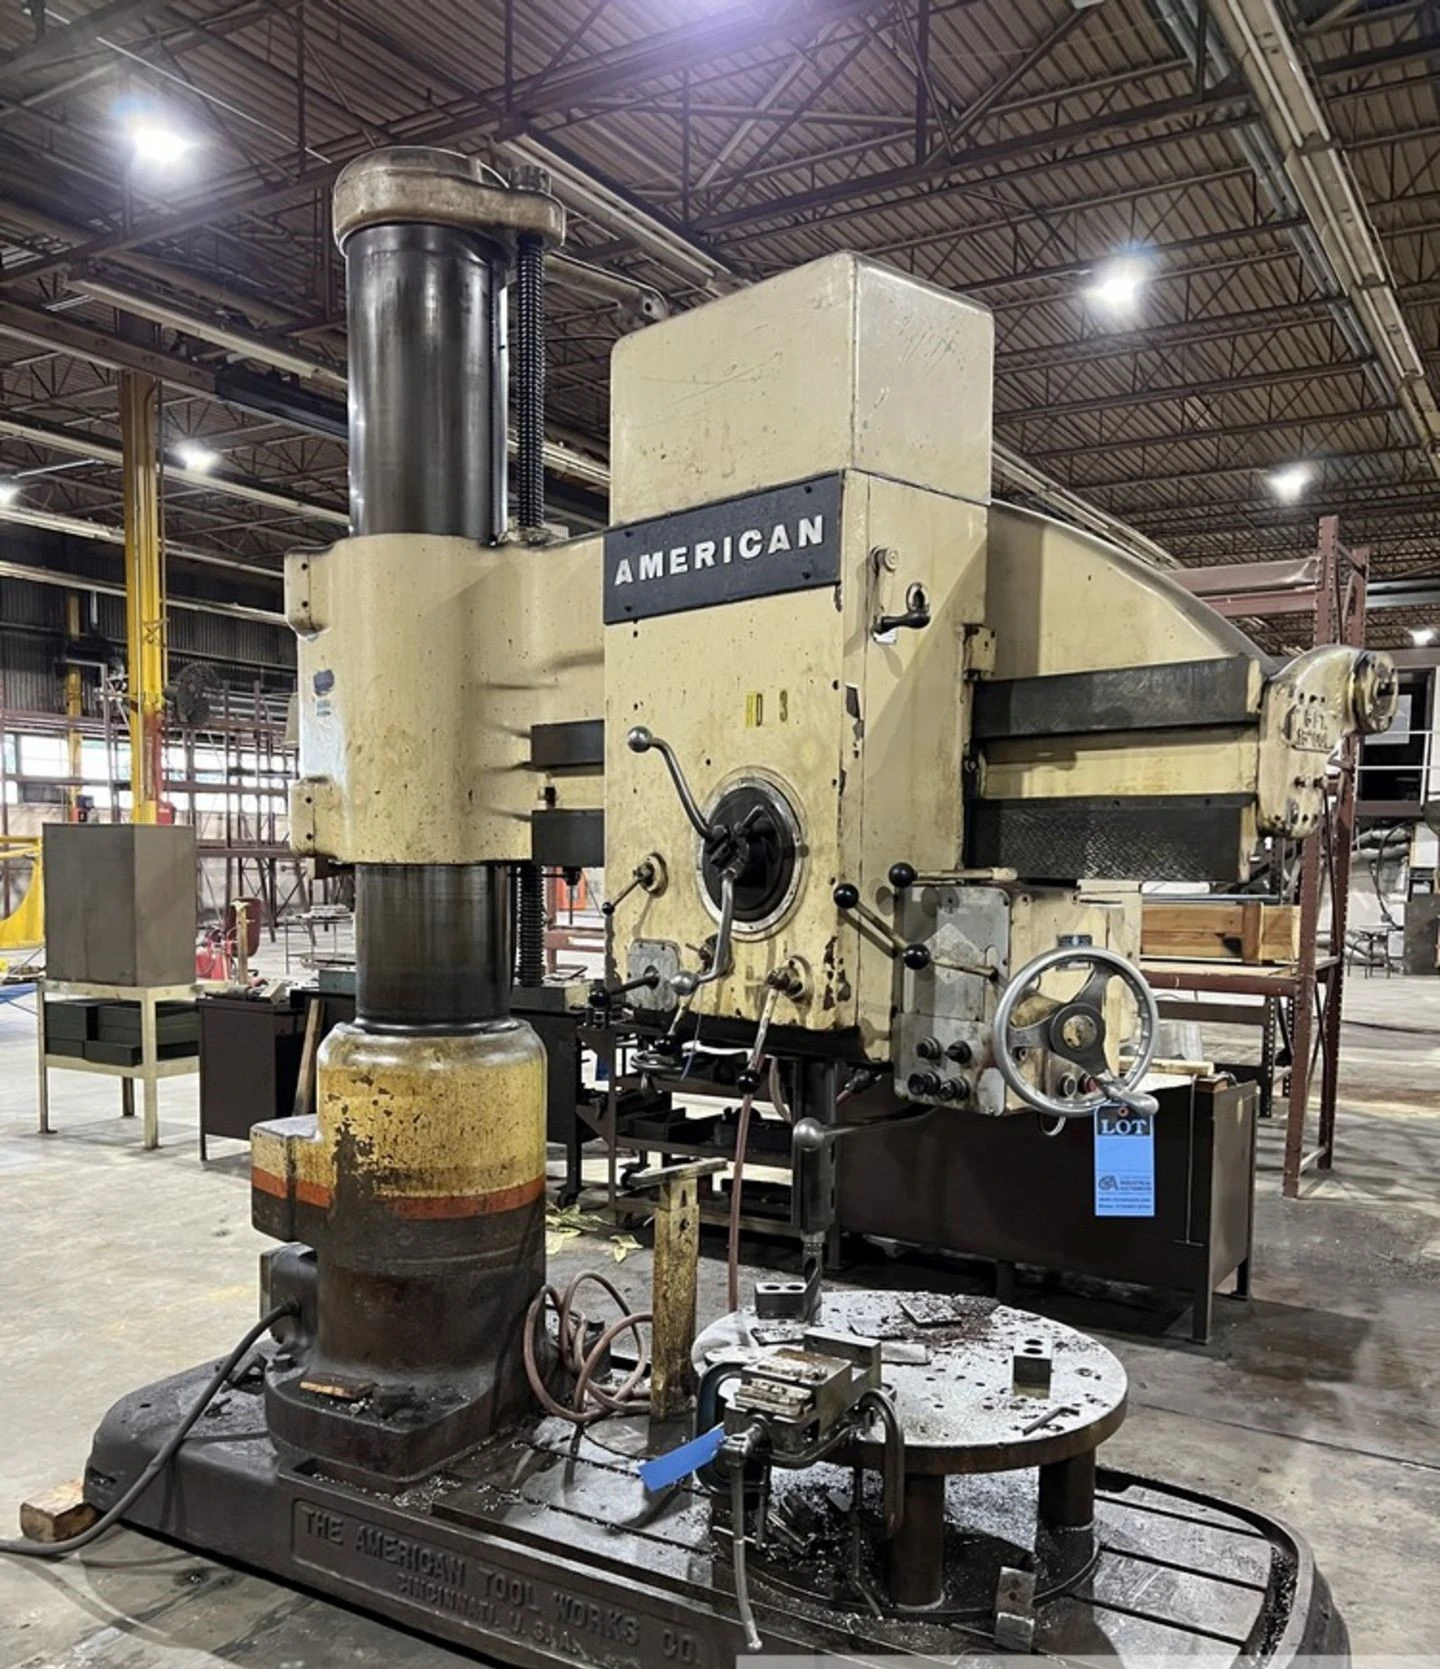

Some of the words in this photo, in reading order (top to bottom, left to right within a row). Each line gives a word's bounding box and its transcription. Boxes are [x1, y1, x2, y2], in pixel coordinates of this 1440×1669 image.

[614, 514, 823, 586] AMERICAN
[1101, 1119, 1147, 1134] LOT
[302, 1507, 345, 1546] THE
[355, 1525, 467, 1588] AMERICAN
[478, 1566, 541, 1613] TOOL
[554, 1590, 640, 1646] WORKS
